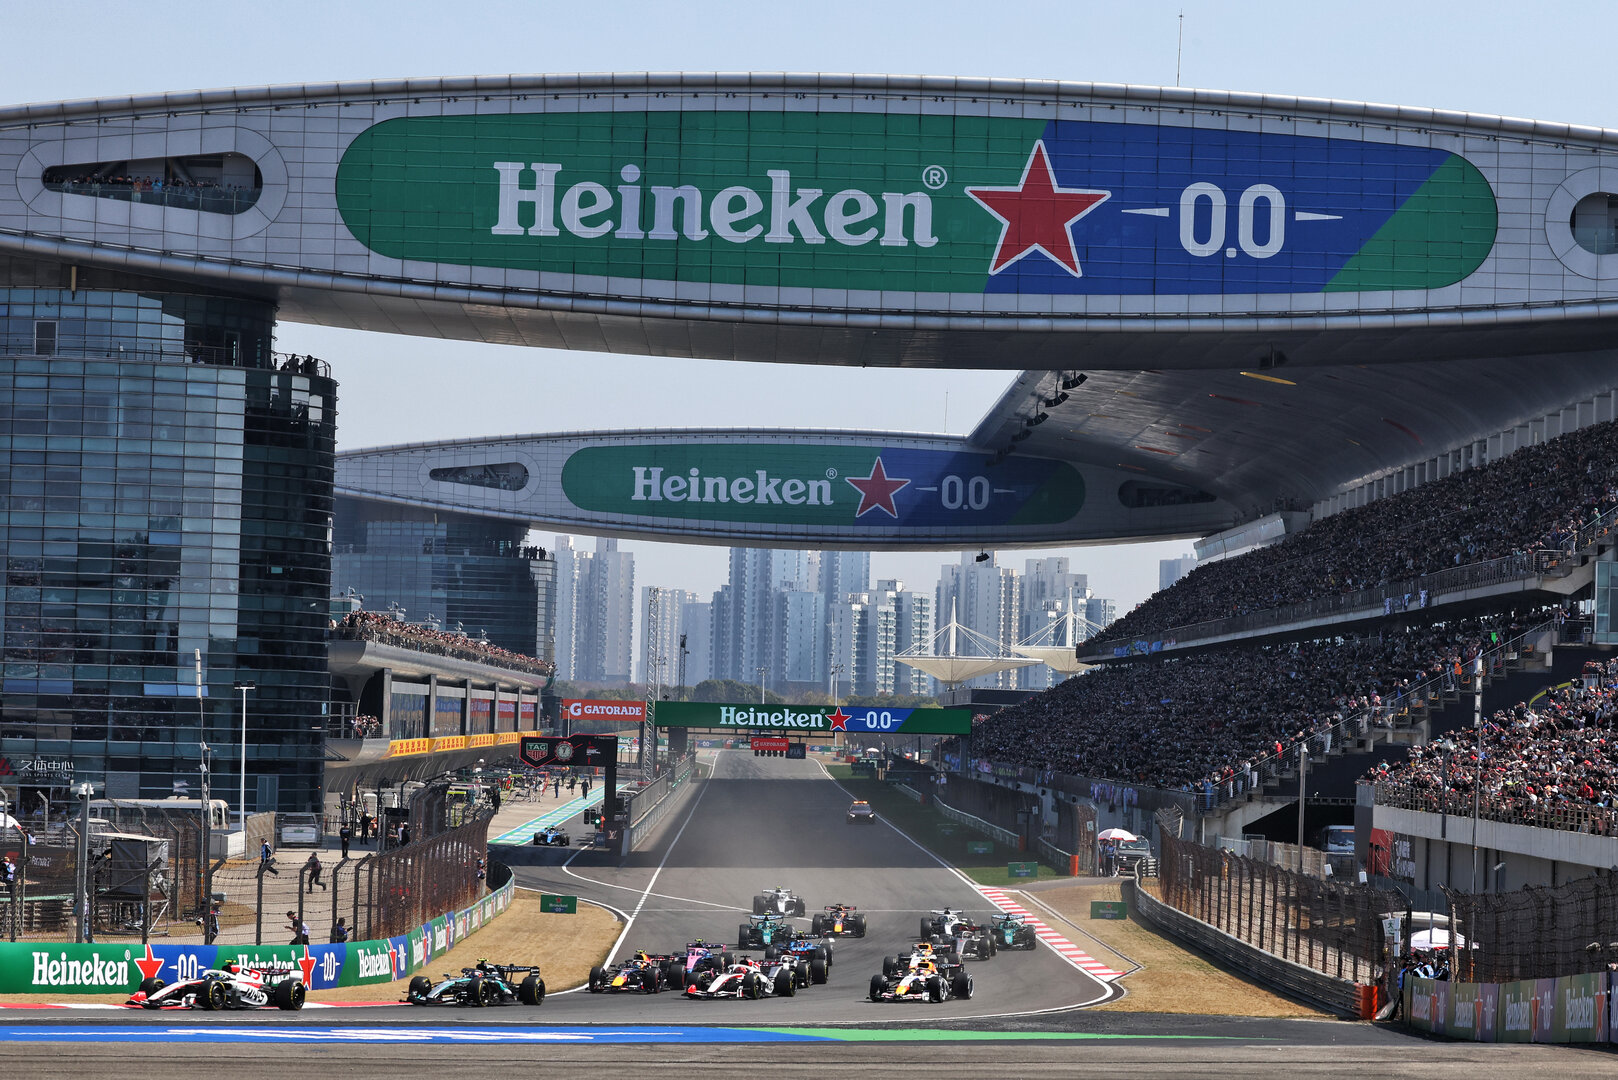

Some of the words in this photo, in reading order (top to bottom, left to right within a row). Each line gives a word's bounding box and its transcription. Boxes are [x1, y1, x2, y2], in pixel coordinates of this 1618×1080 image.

[491, 161, 939, 247] Heineken
[1179, 181, 1286, 259] 0.0
[631, 466, 834, 506] Heineken
[941, 475, 990, 511] 0.0
[584, 705, 642, 716] GATORADE
[719, 706, 824, 728] Heineken
[866, 711, 892, 729] 0.0
[527, 750, 547, 760] HEUER
[32, 952, 129, 986] Heineken
[177, 953, 198, 982] 00
[357, 947, 391, 978] Heineken
